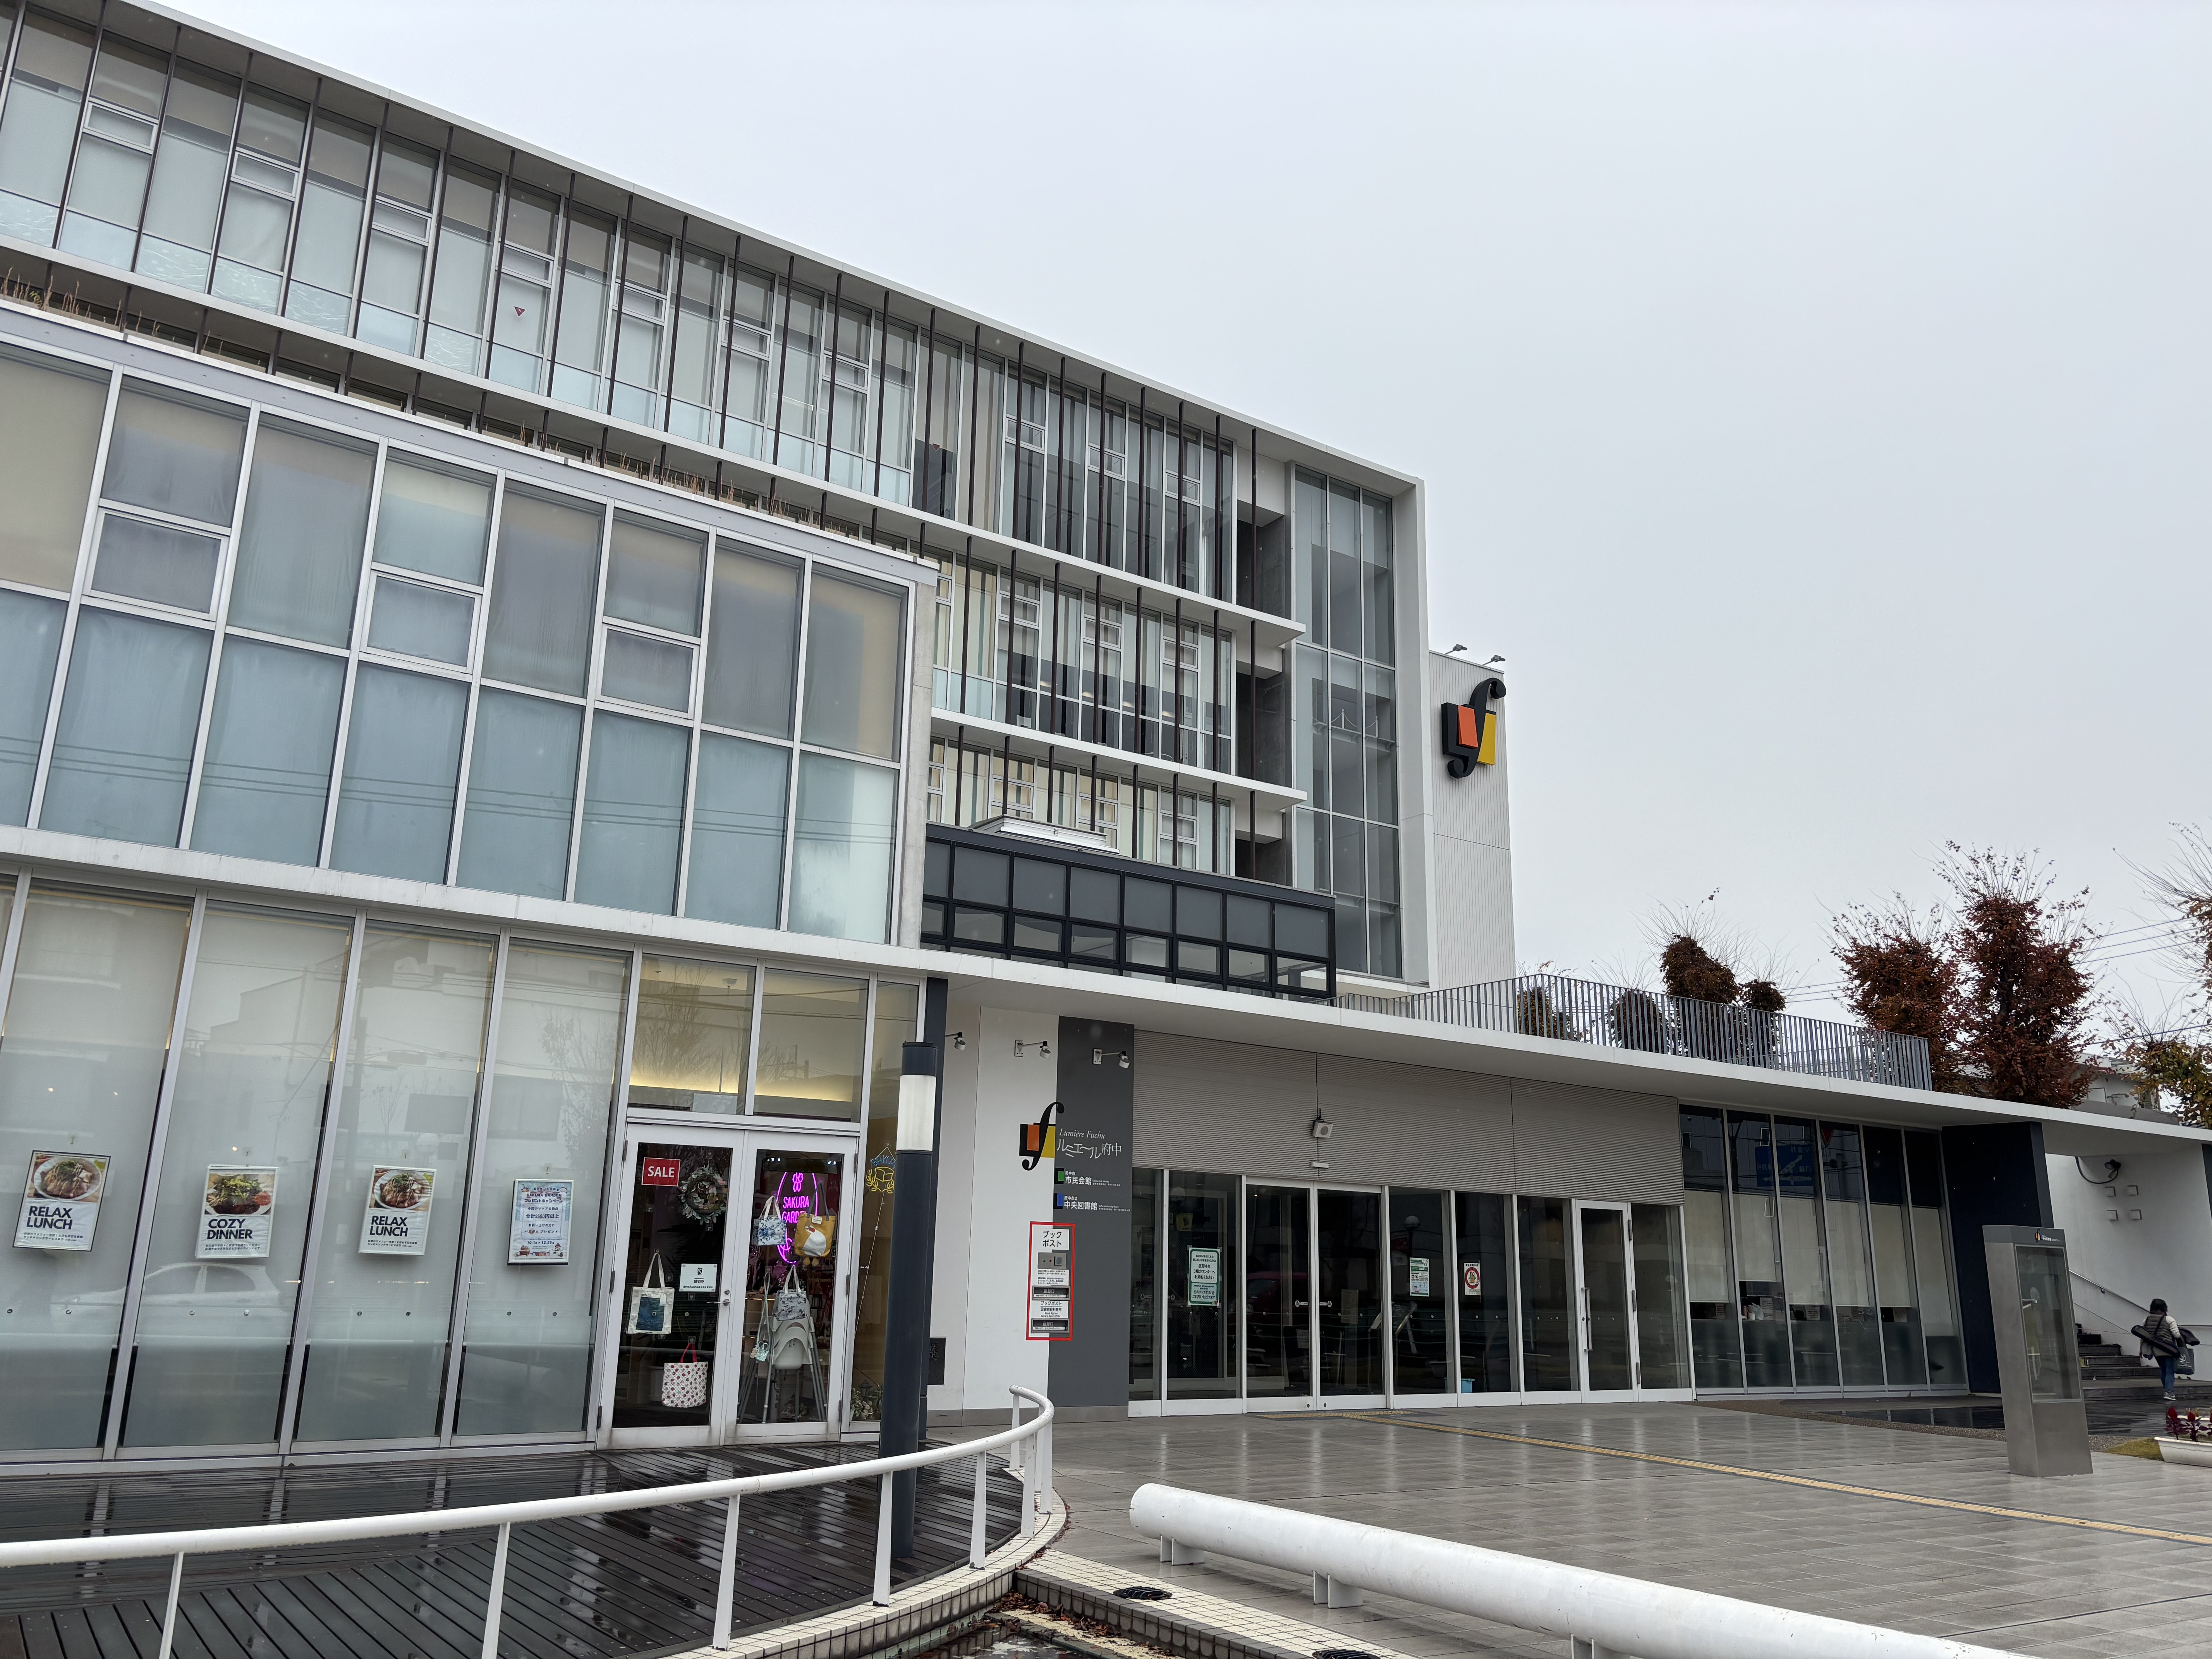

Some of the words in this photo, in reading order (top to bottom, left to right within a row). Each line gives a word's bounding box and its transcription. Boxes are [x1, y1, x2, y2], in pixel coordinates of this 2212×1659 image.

[1059, 1128, 1085, 1137] Lumière
[1086, 1130, 1105, 1139] Fuchu
[647, 1166, 675, 1178] SALE
[1065, 1176, 1092, 1185] 市民会館
[783, 1196, 809, 1209] SAKURA
[1064, 1200, 1097, 1210] 中央図書館
[28, 1206, 73, 1219] RELAX
[781, 1211, 807, 1223] GARD
[26, 1217, 73, 1230] LUNCH
[208, 1218, 246, 1229] COZY
[371, 1216, 408, 1226] RELAX
[207, 1229, 253, 1239] DINNER
[369, 1226, 408, 1237] LUNCH
